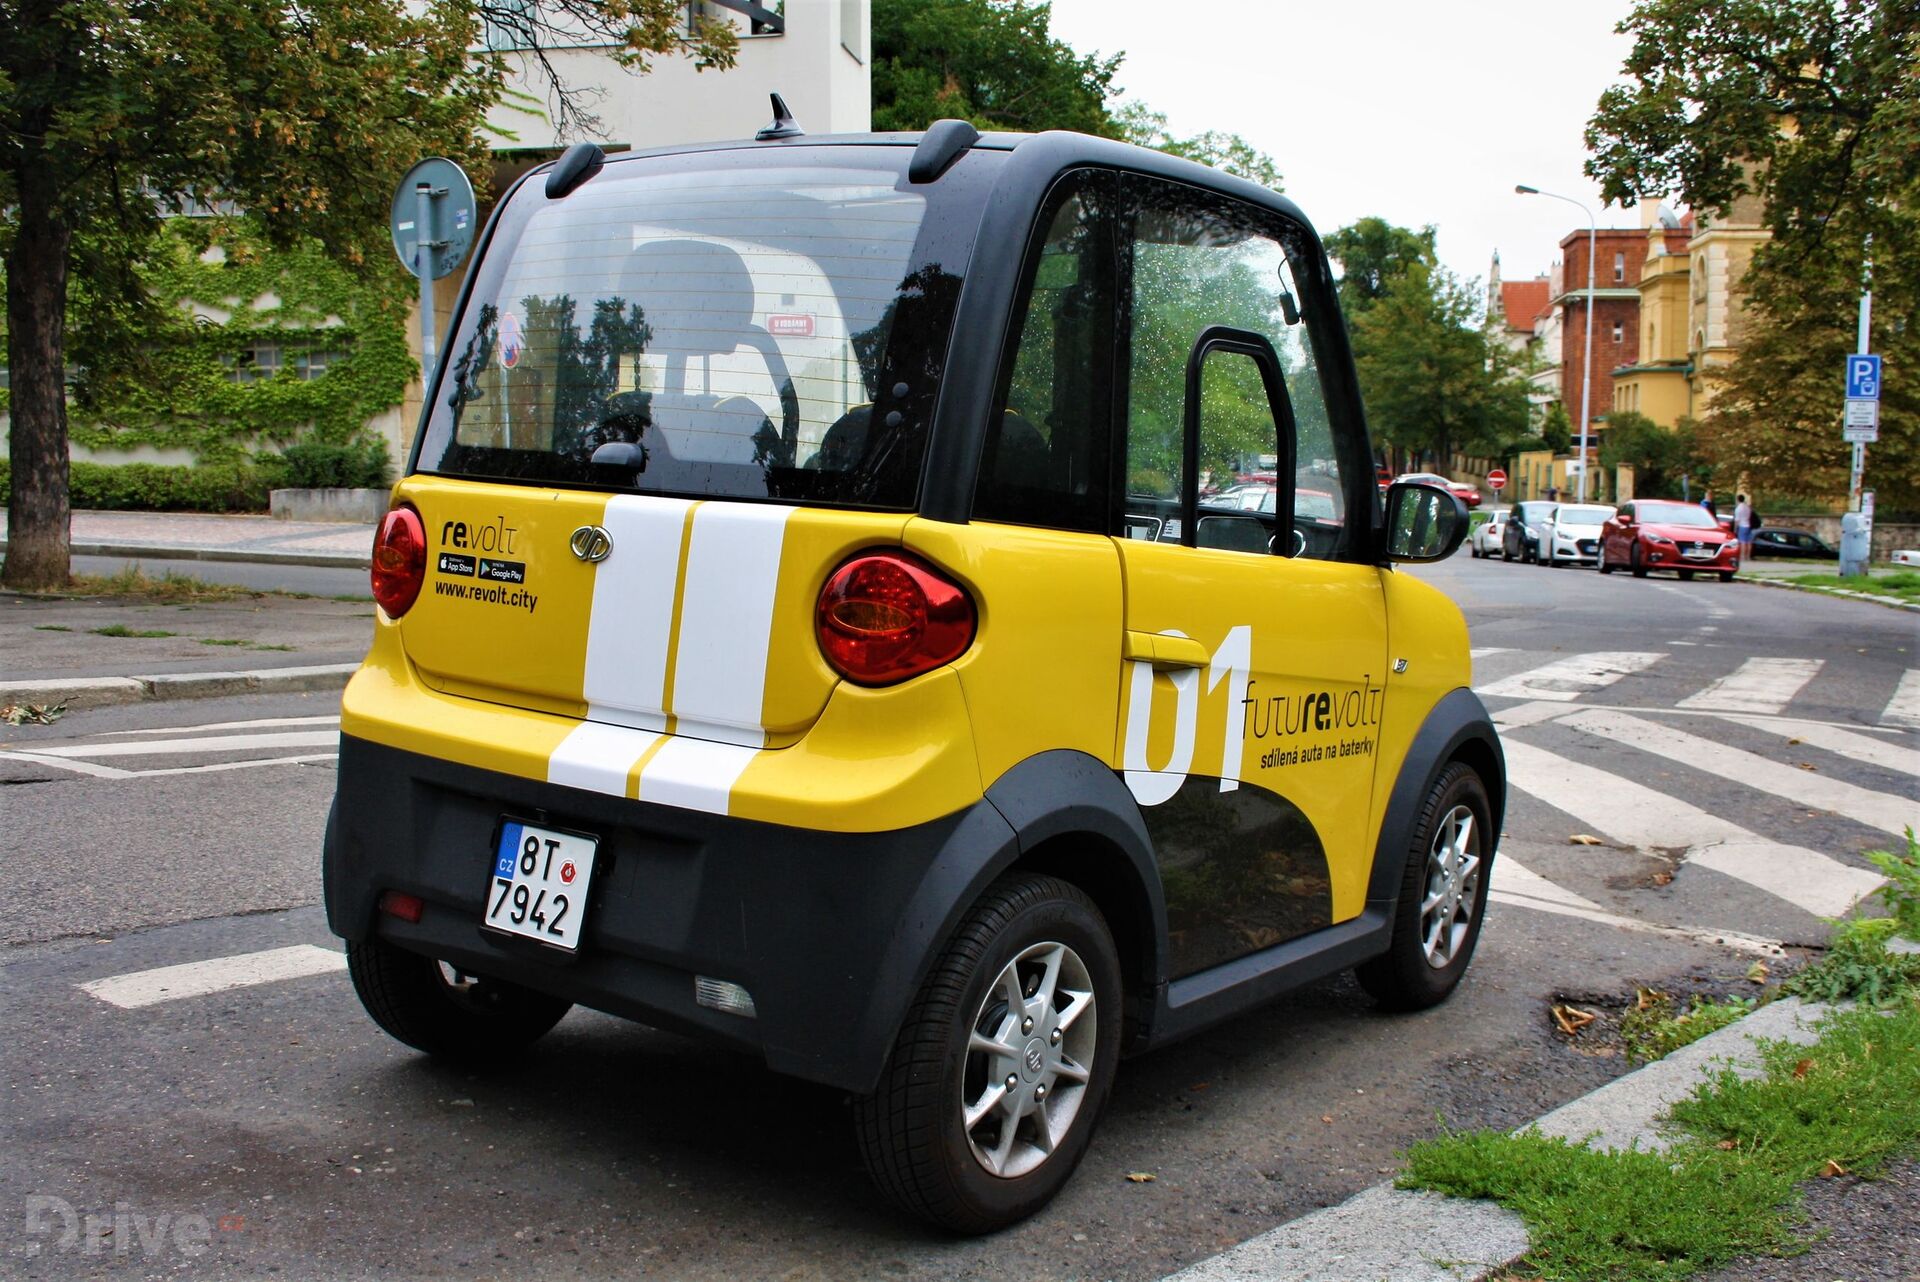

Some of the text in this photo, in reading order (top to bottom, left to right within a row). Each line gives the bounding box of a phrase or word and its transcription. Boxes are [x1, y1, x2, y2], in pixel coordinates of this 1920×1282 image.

[1853, 360, 1873, 386] P
[447, 562, 474, 573] App Store
[491, 568, 523, 582] Google Play
[435, 580, 538, 614] www.revolt.city
[1260, 736, 1375, 769] sdílená auta na baterky
[499, 858, 514, 873] CZ
[520, 835, 560, 881] 8T
[491, 878, 569, 936] 7942
